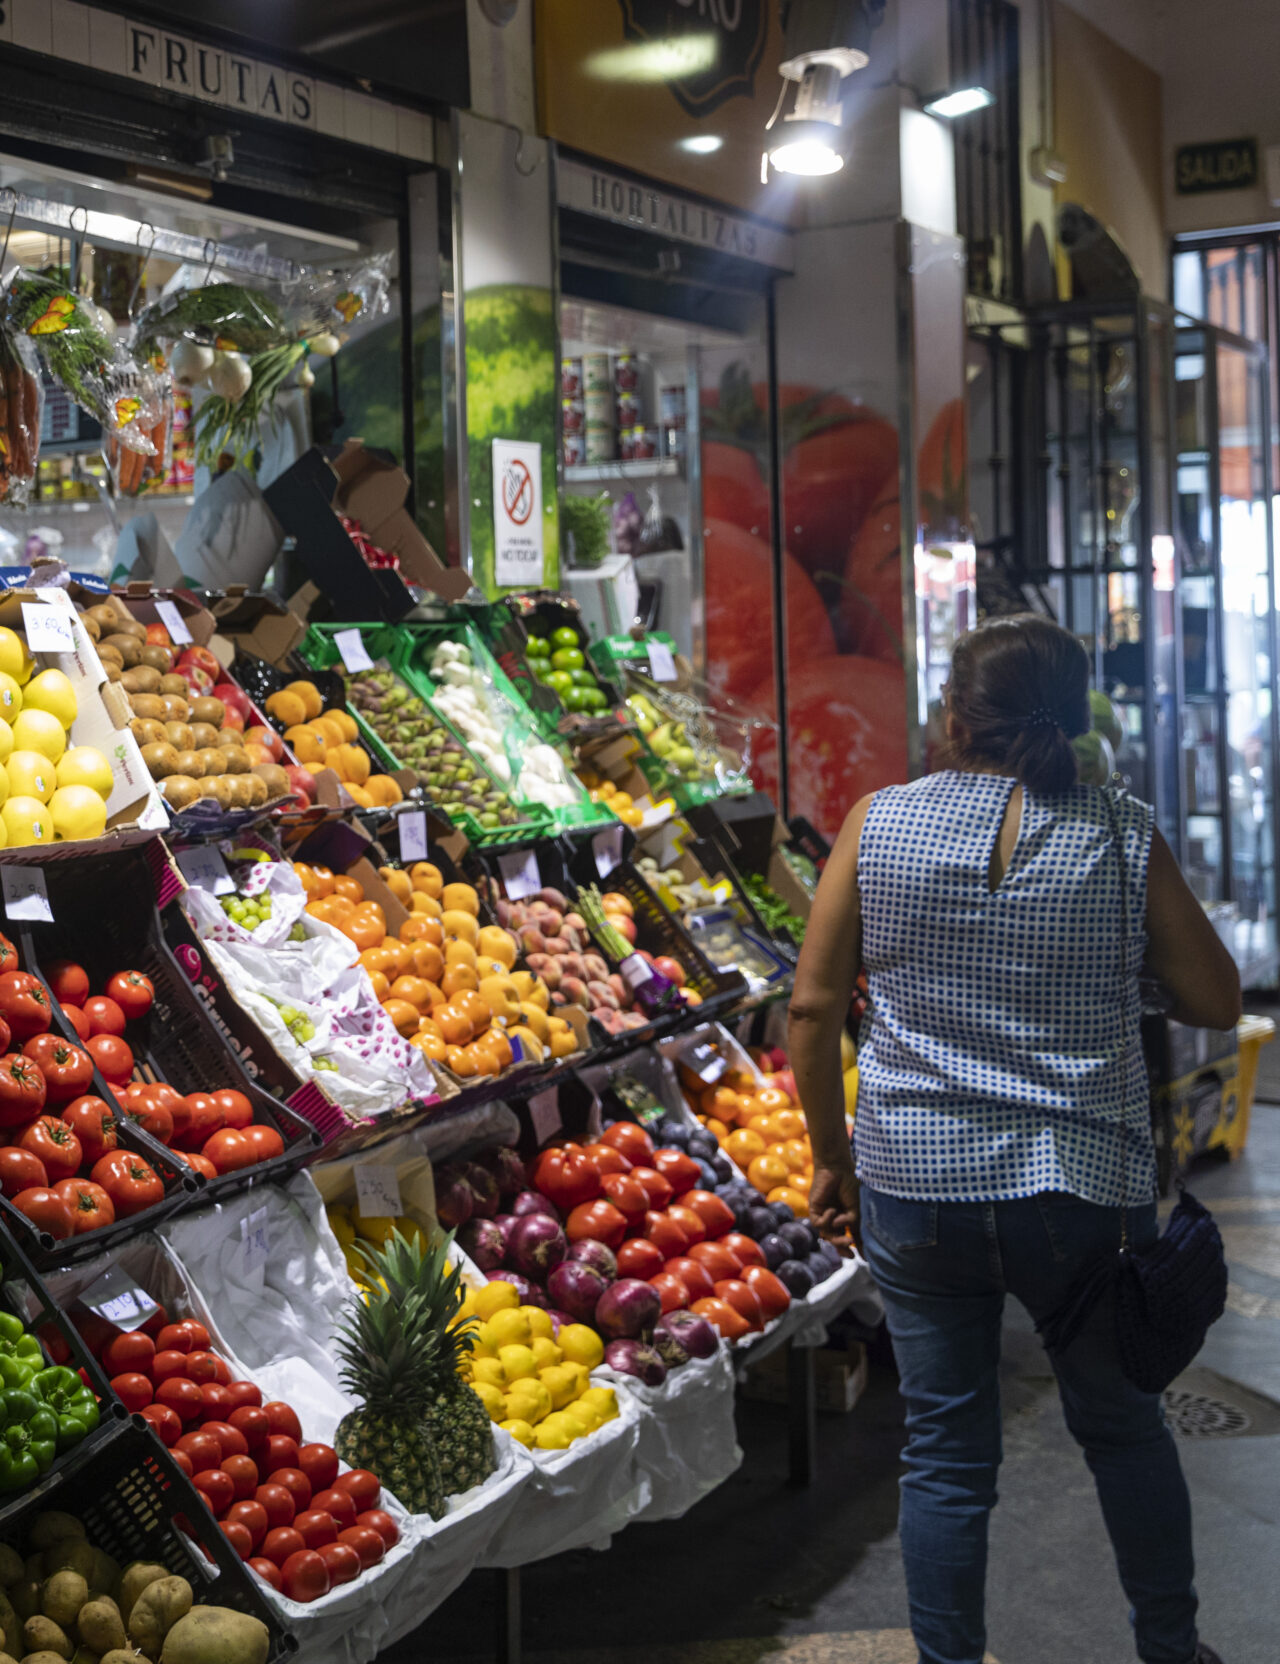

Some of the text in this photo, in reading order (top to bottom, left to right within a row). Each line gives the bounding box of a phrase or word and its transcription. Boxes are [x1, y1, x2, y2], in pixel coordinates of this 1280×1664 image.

[130, 27, 312, 121] FRUTAS
[1180, 148, 1253, 186] SALIDA
[591, 173, 758, 257] HORTALIZAS
